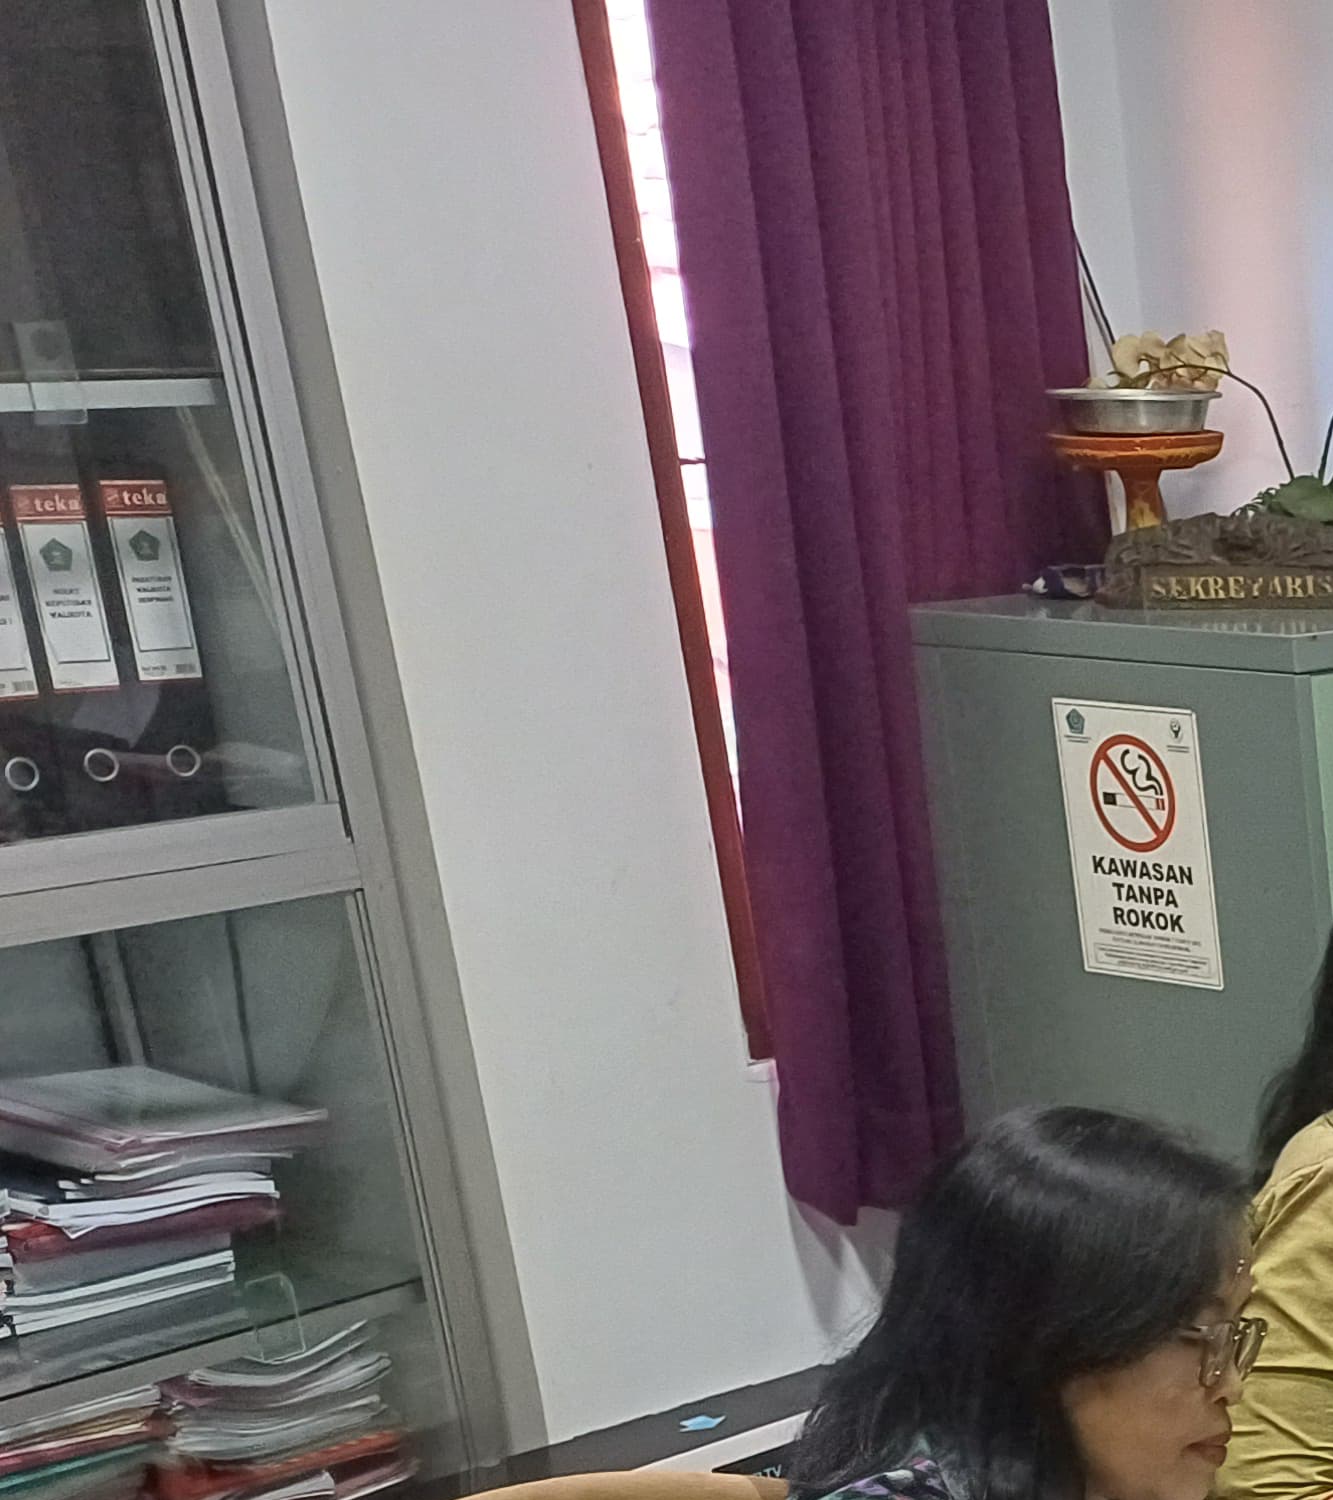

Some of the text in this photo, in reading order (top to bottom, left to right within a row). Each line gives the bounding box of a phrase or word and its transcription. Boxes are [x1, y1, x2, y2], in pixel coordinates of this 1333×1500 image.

[34, 494, 81, 513] teka
[122, 487, 168, 506] teka
[1151, 574, 1333, 600] SEKRETARIS
[1091, 855, 1194, 885] KAWASAN
[1112, 882, 1179, 908] TANPA
[1112, 906, 1185, 933] ROKOK
